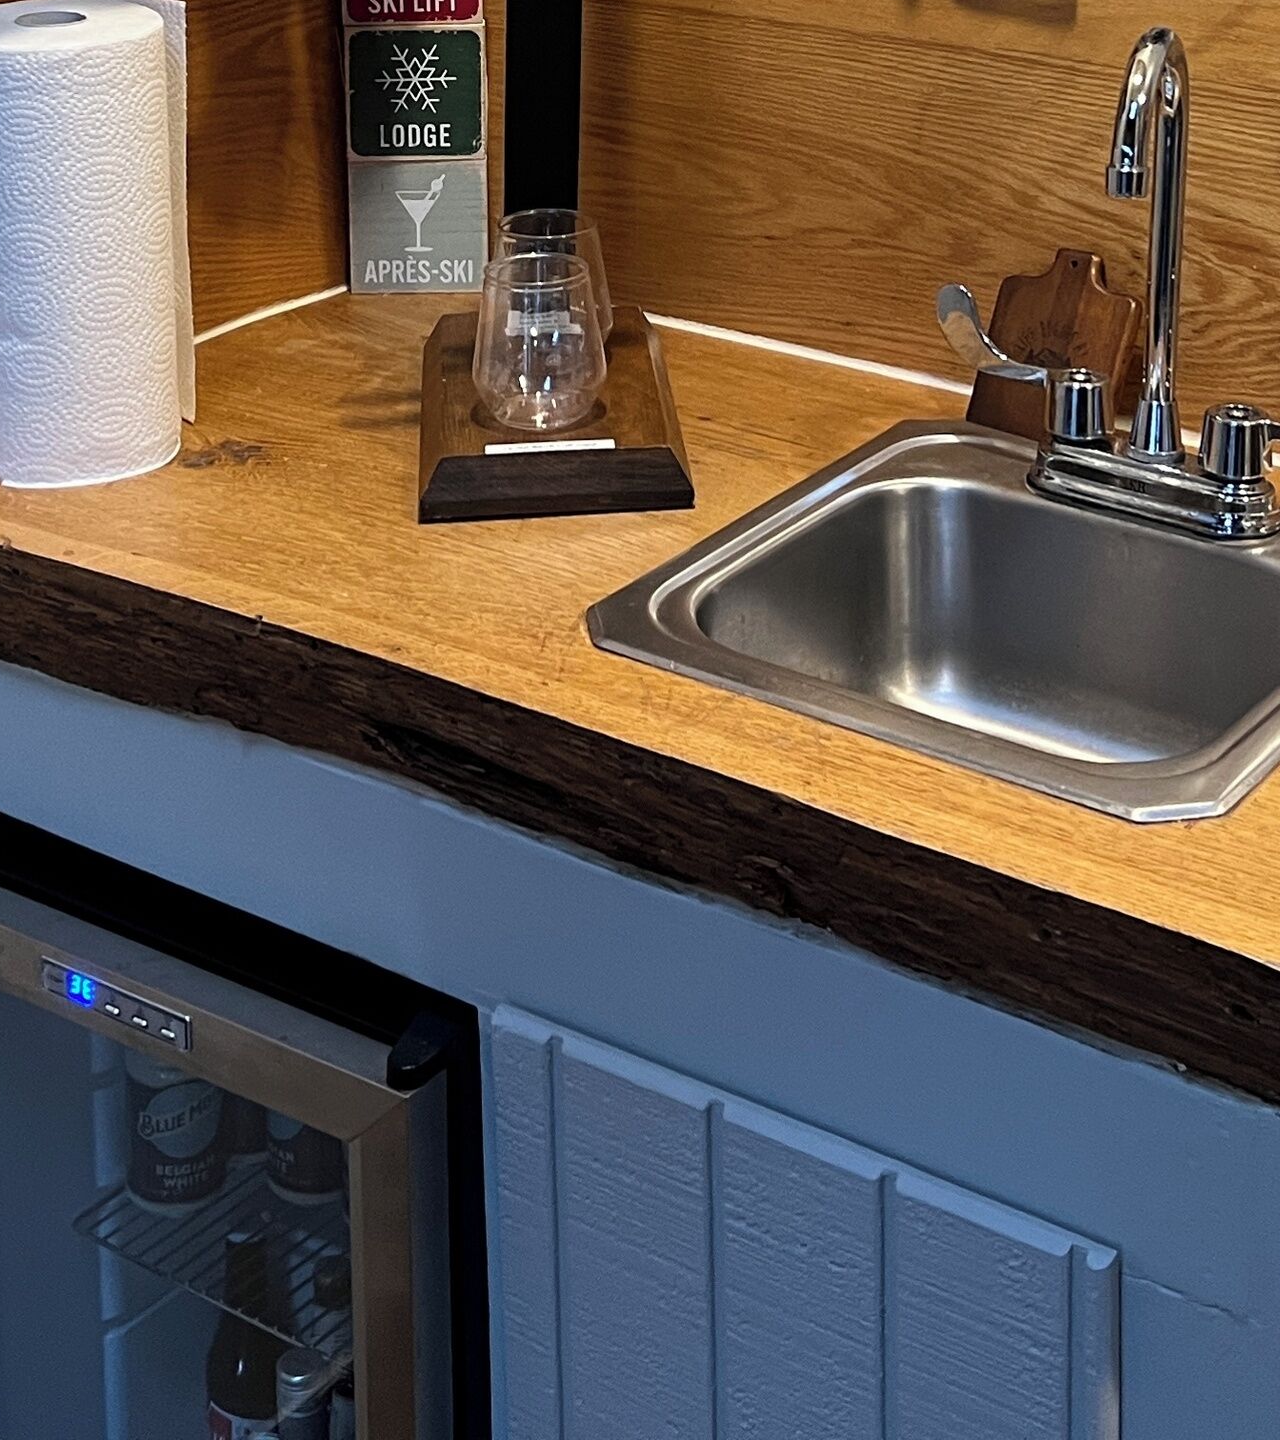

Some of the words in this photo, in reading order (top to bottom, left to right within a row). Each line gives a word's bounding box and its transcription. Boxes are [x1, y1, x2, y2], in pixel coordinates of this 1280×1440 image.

[379, 123, 452, 148] LODGE
[364, 254, 473, 283] APRÈS-SKI
[138, 1109, 187, 1137] BLUE
[155, 1152, 216, 1176] BELGIAN
[162, 1168, 208, 1190] WHITE
